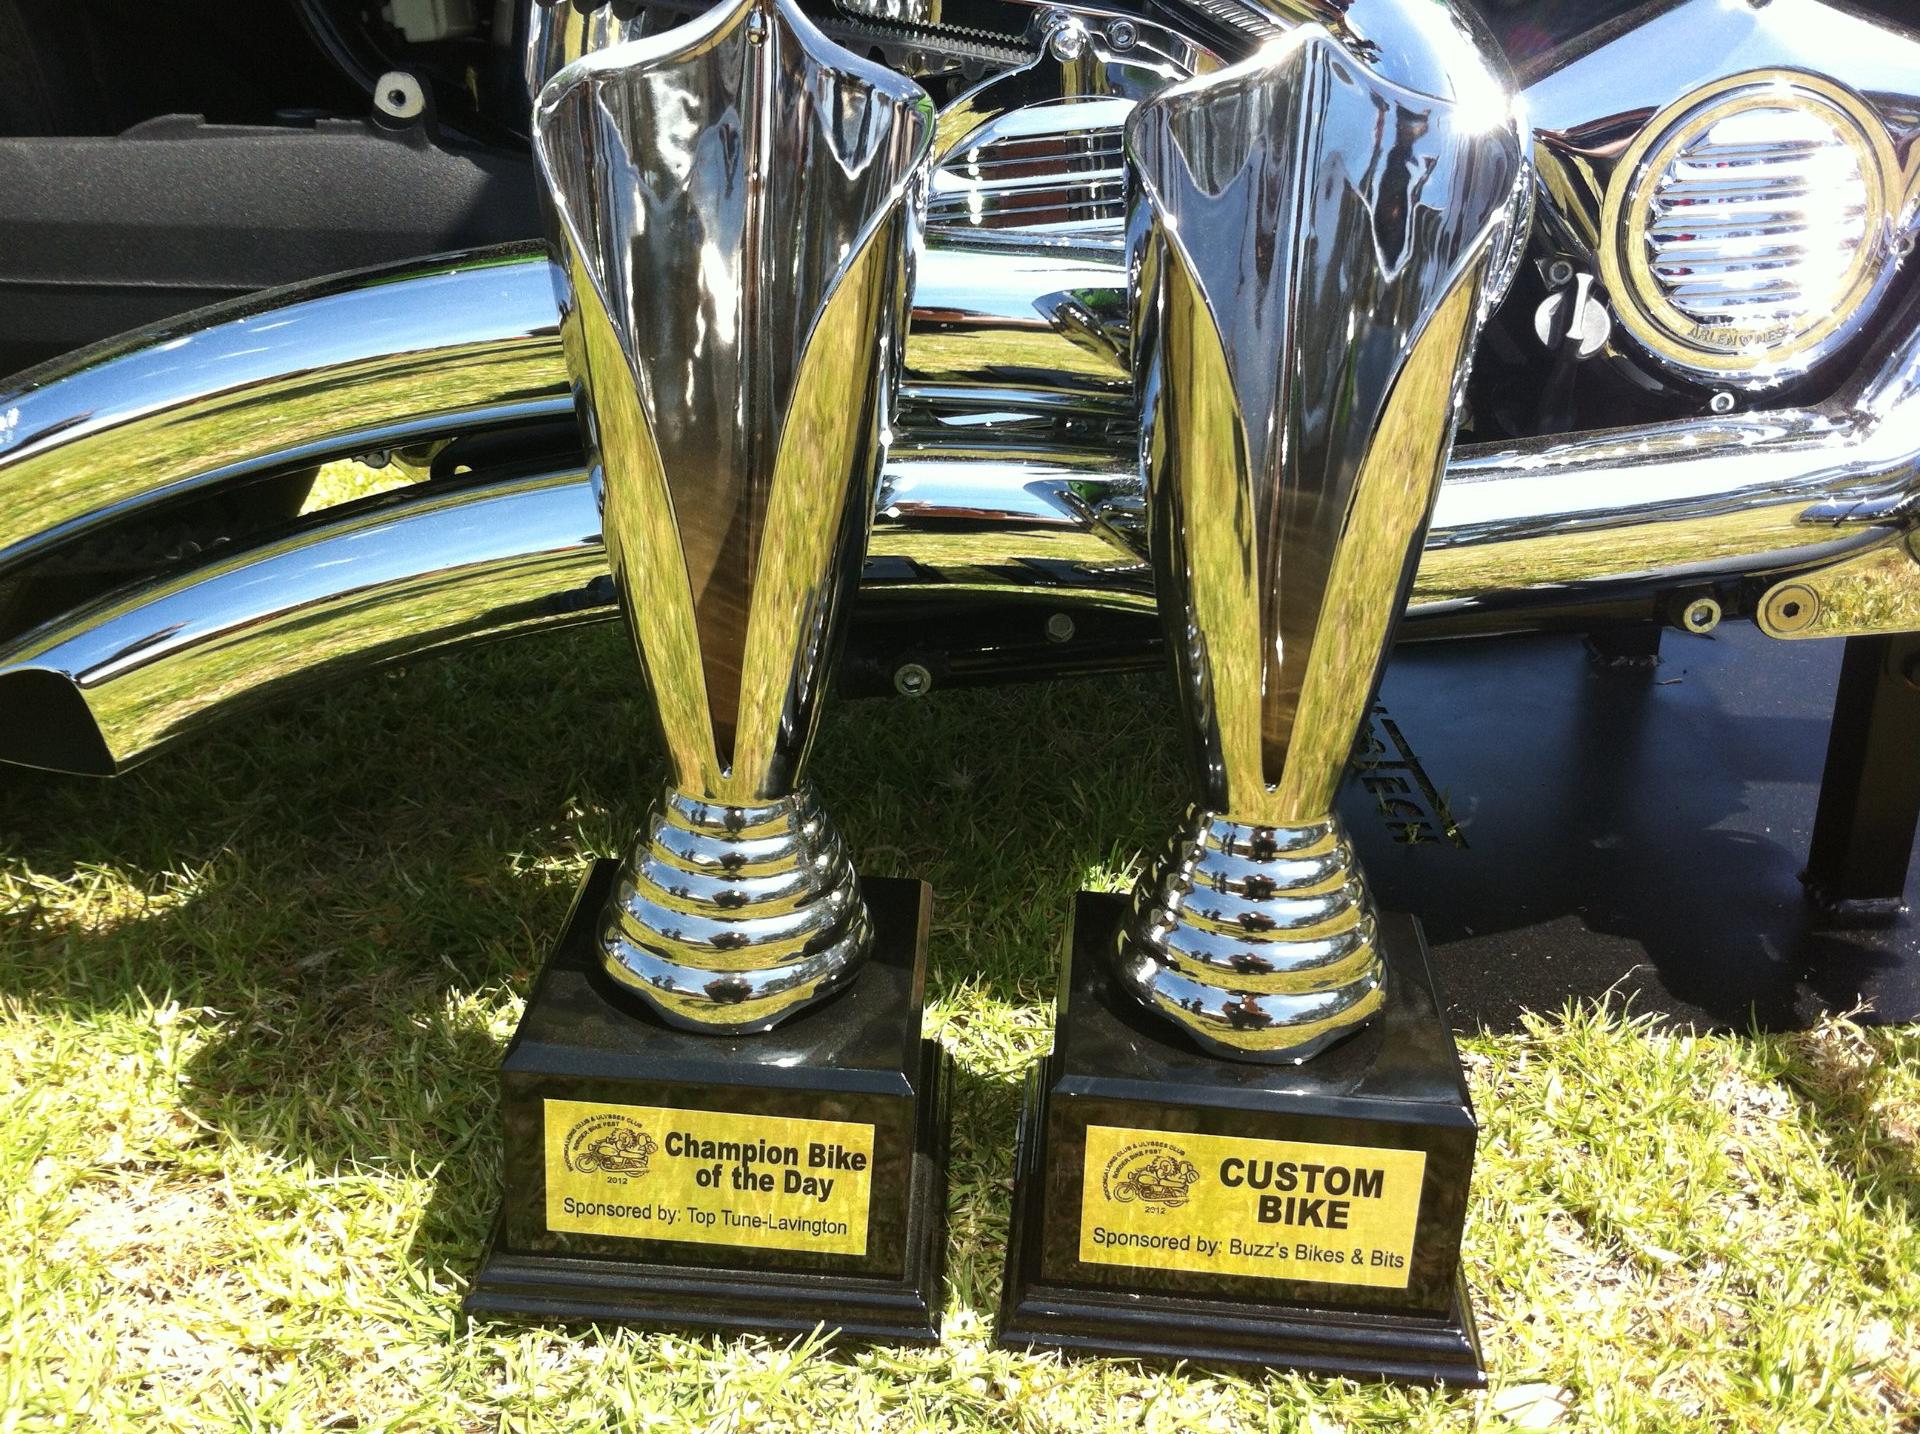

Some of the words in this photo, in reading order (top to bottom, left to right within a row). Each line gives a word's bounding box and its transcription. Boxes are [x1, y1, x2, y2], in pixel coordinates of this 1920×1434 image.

[1687, 324, 1737, 346] ARLEN
[665, 1132, 798, 1167] Champion
[808, 1143, 867, 1171] Bike
[607, 1176, 628, 1184] 2012
[696, 1164, 722, 1188] of
[732, 1165, 774, 1191] the
[784, 1169, 834, 1202] Day
[1219, 1157, 1384, 1199] CUSTOM
[564, 1197, 652, 1219] Sponsored
[657, 1205, 681, 1224] by:
[687, 1207, 716, 1227] Top
[721, 1210, 847, 1236] Tune-Lavington
[1144, 1206, 1167, 1214] 2012
[1257, 1195, 1350, 1230] BIKE
[1093, 1227, 1190, 1251] Sponsored
[1196, 1236, 1222, 1257] by:
[1229, 1238, 1289, 1259] Buzz's
[1295, 1244, 1345, 1264] Bikes
[1350, 1248, 1364, 1265] &
[1370, 1250, 1405, 1268] Bits
